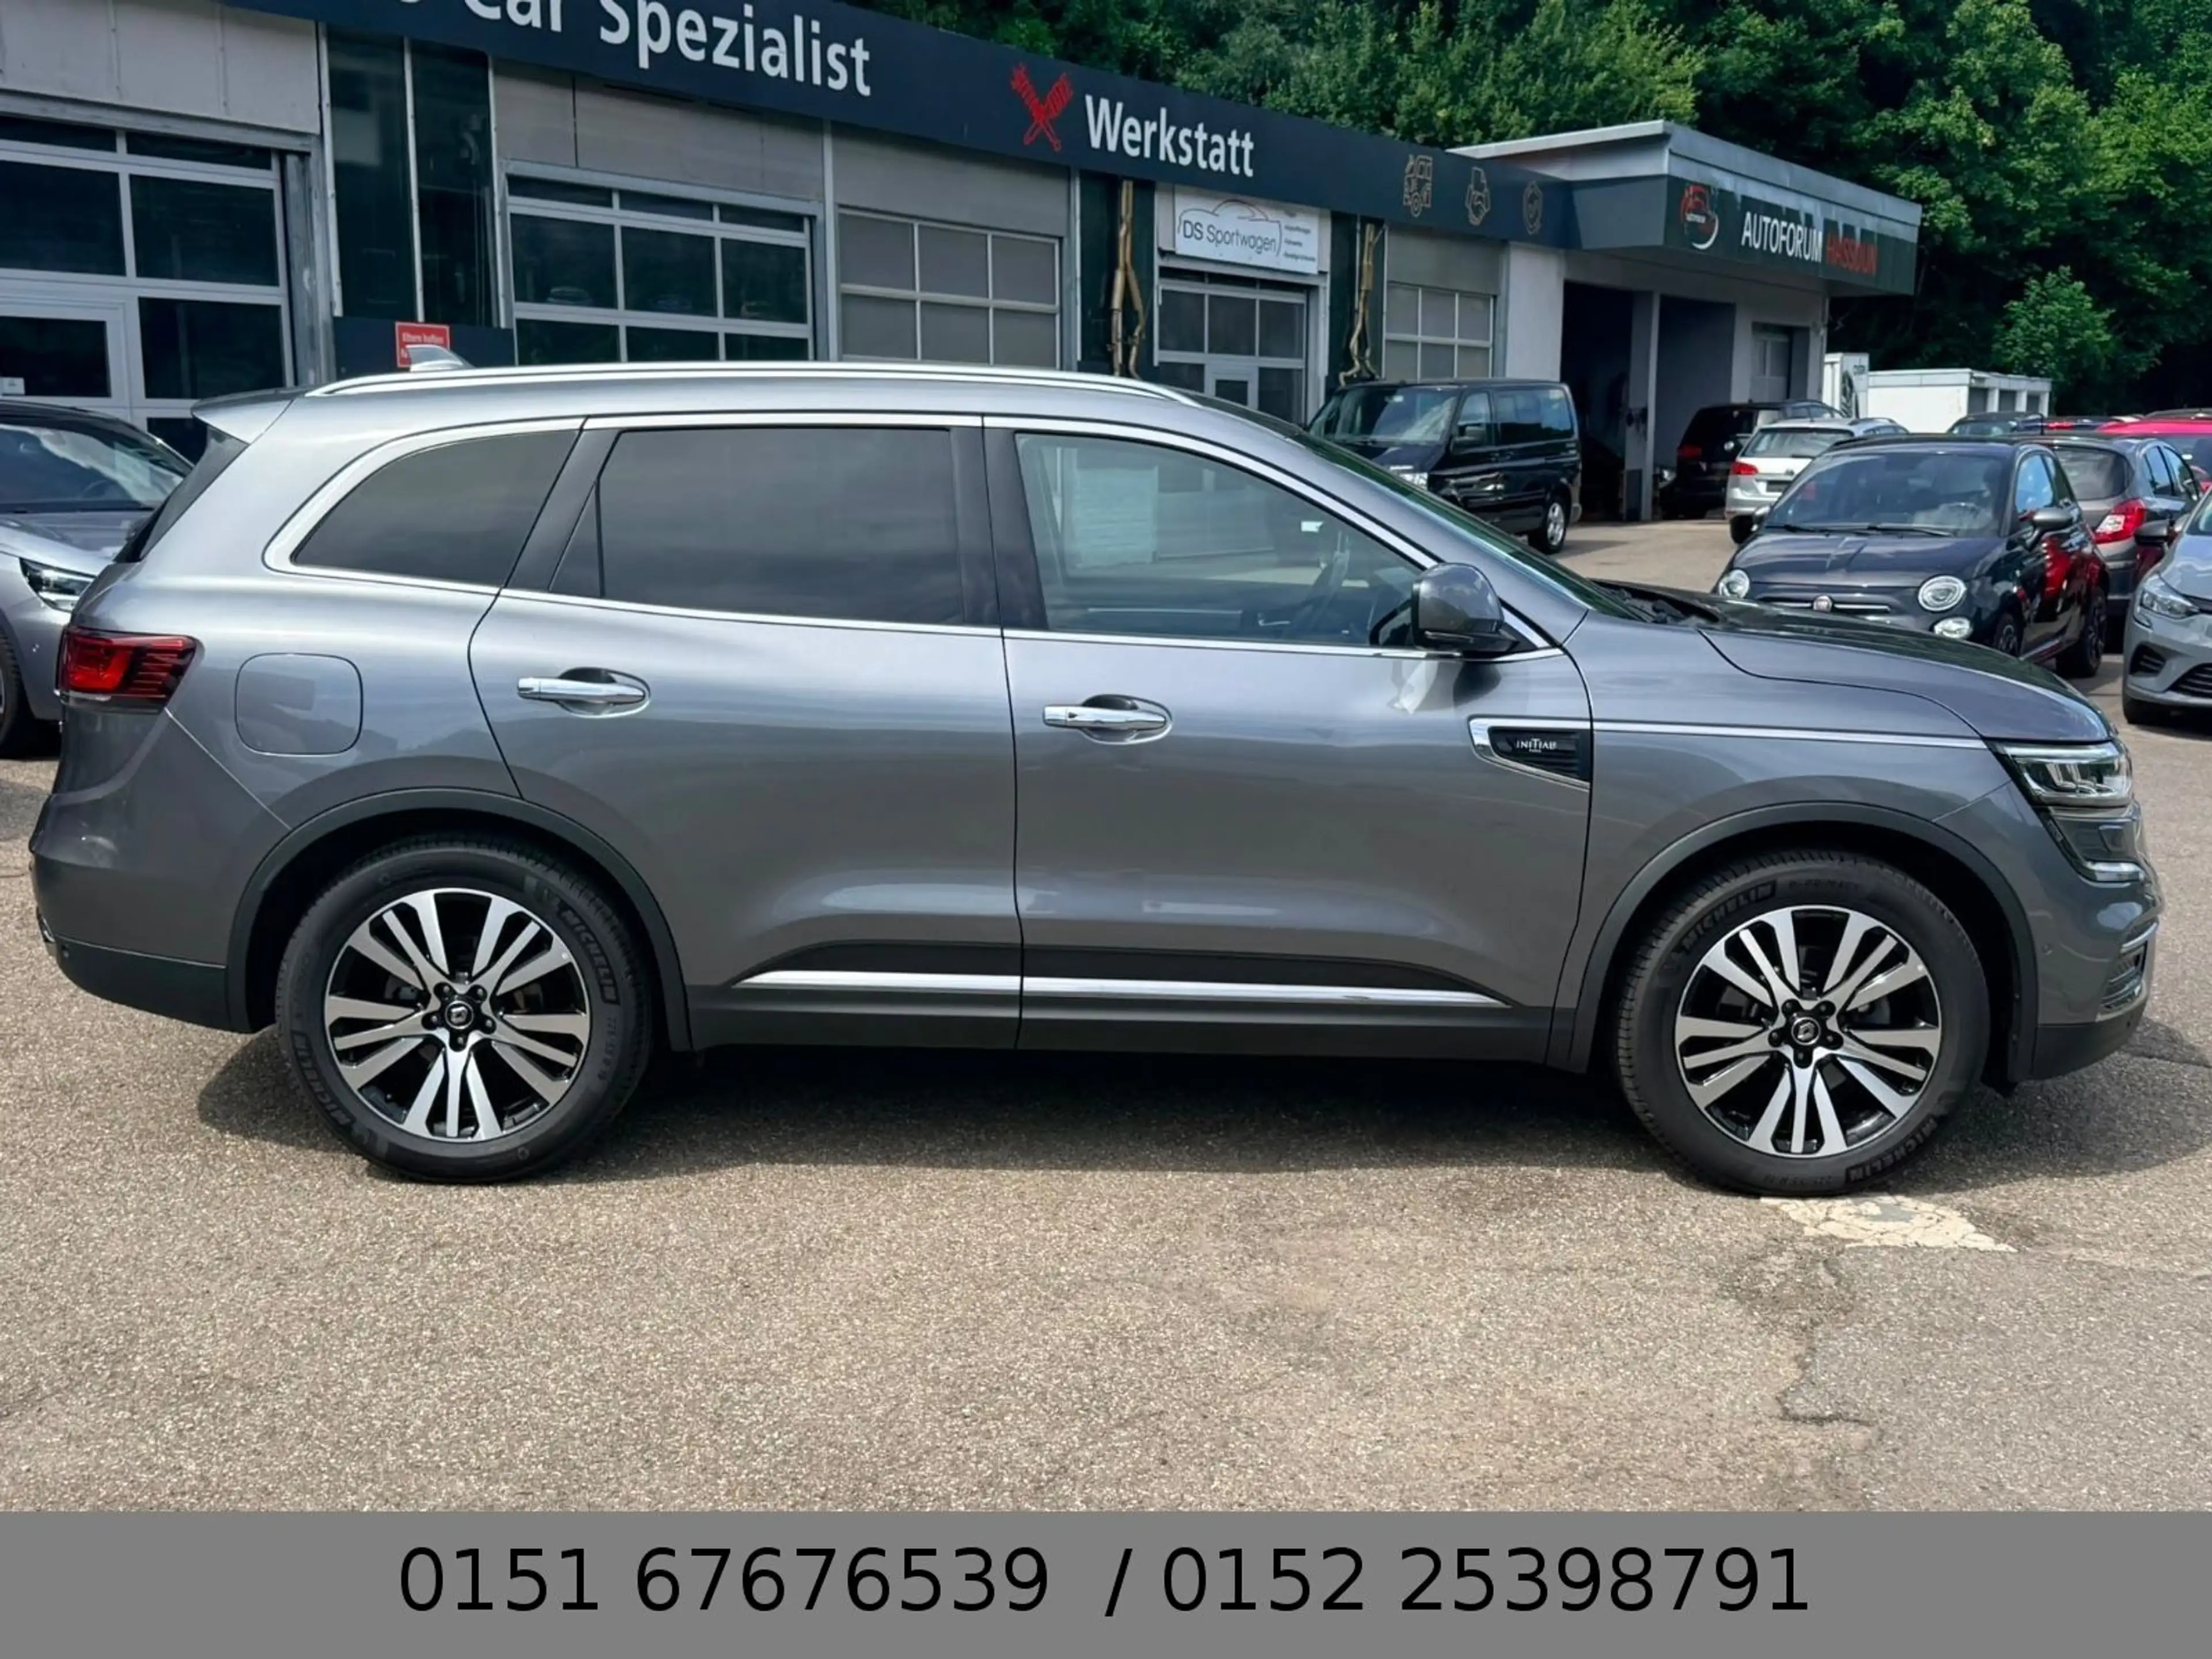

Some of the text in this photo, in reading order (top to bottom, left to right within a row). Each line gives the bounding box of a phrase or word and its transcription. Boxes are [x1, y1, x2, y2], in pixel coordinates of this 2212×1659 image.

[600, 0, 870, 96] Spezialist
[1085, 94, 1254, 177] Werkstatt
[1183, 219, 1277, 255] DS Sportwagen
[1740, 211, 1823, 263] AUTOFORUM
[560, 908, 617, 1001] MICHELIN
